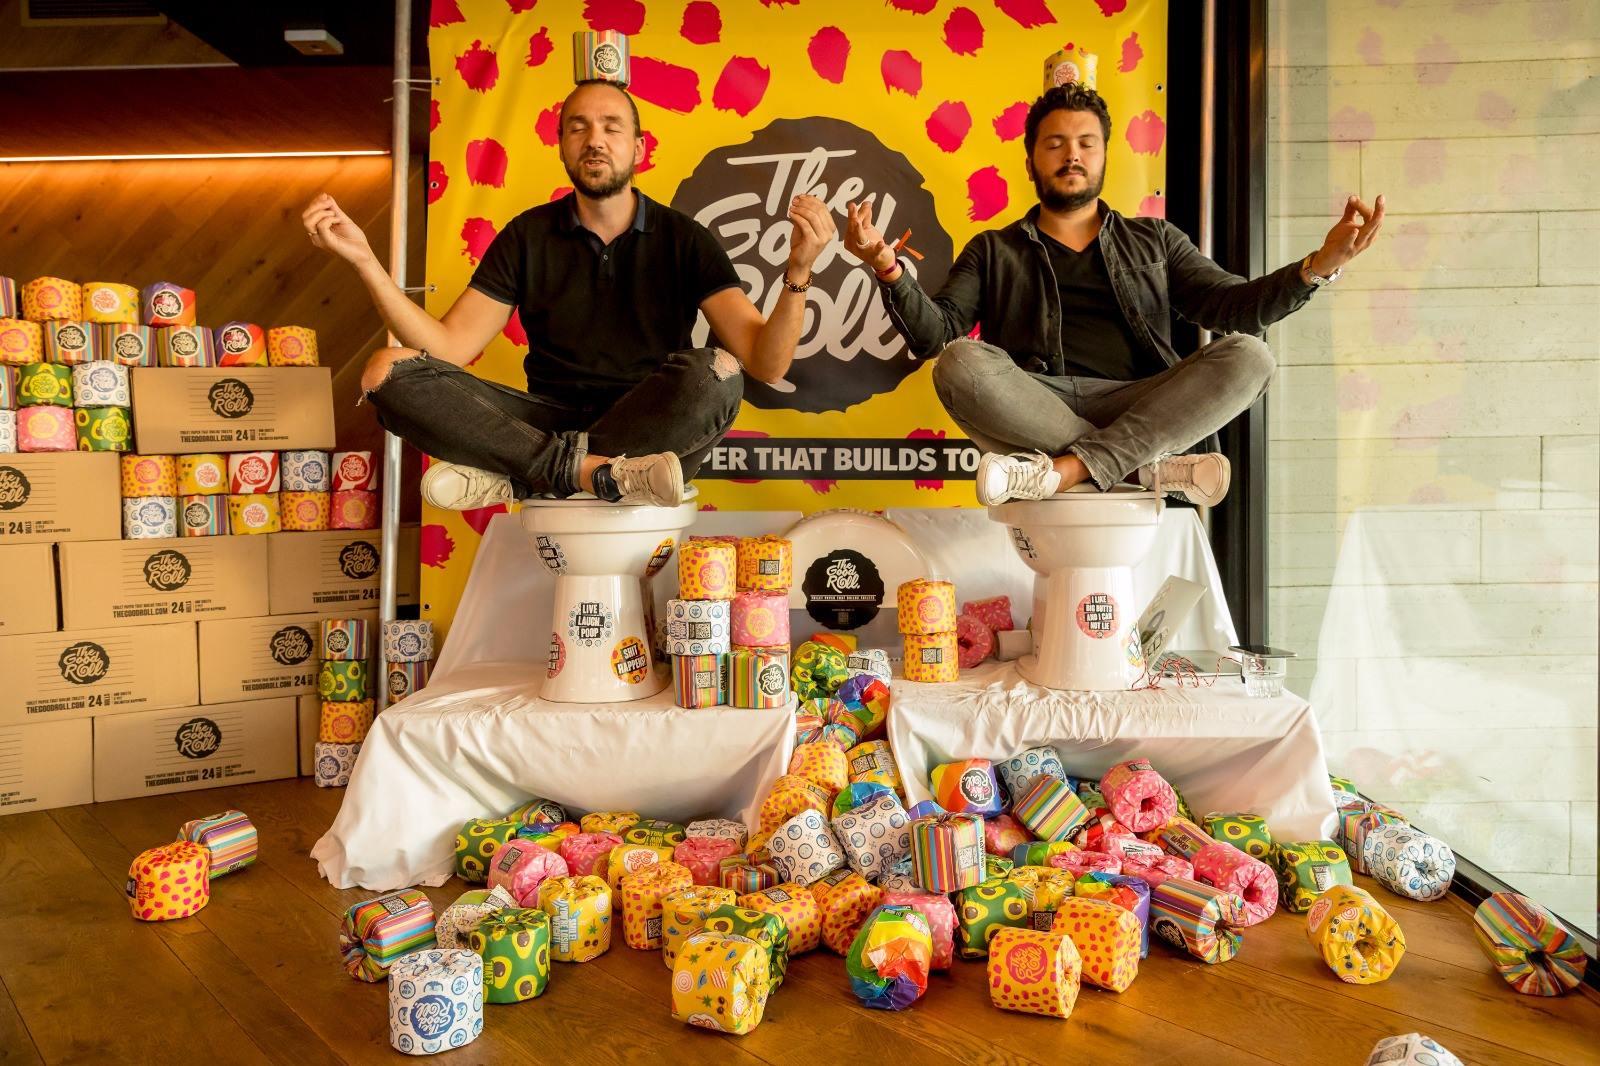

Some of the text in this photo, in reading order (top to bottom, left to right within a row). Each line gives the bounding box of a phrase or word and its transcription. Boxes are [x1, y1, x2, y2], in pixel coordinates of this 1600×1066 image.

[218, 382, 242, 392] The
[212, 388, 246, 400] Good
[236, 430, 248, 440] 24
[754, 448, 828, 470] THAT
[834, 448, 937, 472] BUILDS
[8, 522, 24, 534] 24
[348, 544, 368, 554] The
[153, 554, 178, 564] The
[343, 551, 374, 561] Good
[148, 560, 182, 572] Good
[832, 558, 852, 569] The
[826, 564, 857, 577] Good
[362, 588, 374, 600] 24
[171, 602, 184, 614] 24
[582, 604, 598, 614] LIVE
[280, 630, 300, 640] The
[581, 628, 599, 638] POOP
[274, 636, 306, 648] Good
[69, 645, 96, 657] The
[623, 644, 638, 660] SHIT
[63, 651, 101, 665] Good
[294, 675, 306, 687] 24
[88, 694, 102, 708] 24
[186, 721, 208, 732] The
[180, 726, 213, 740] Good
[202, 768, 214, 780] 24
[420, 1023, 446, 1036] The
